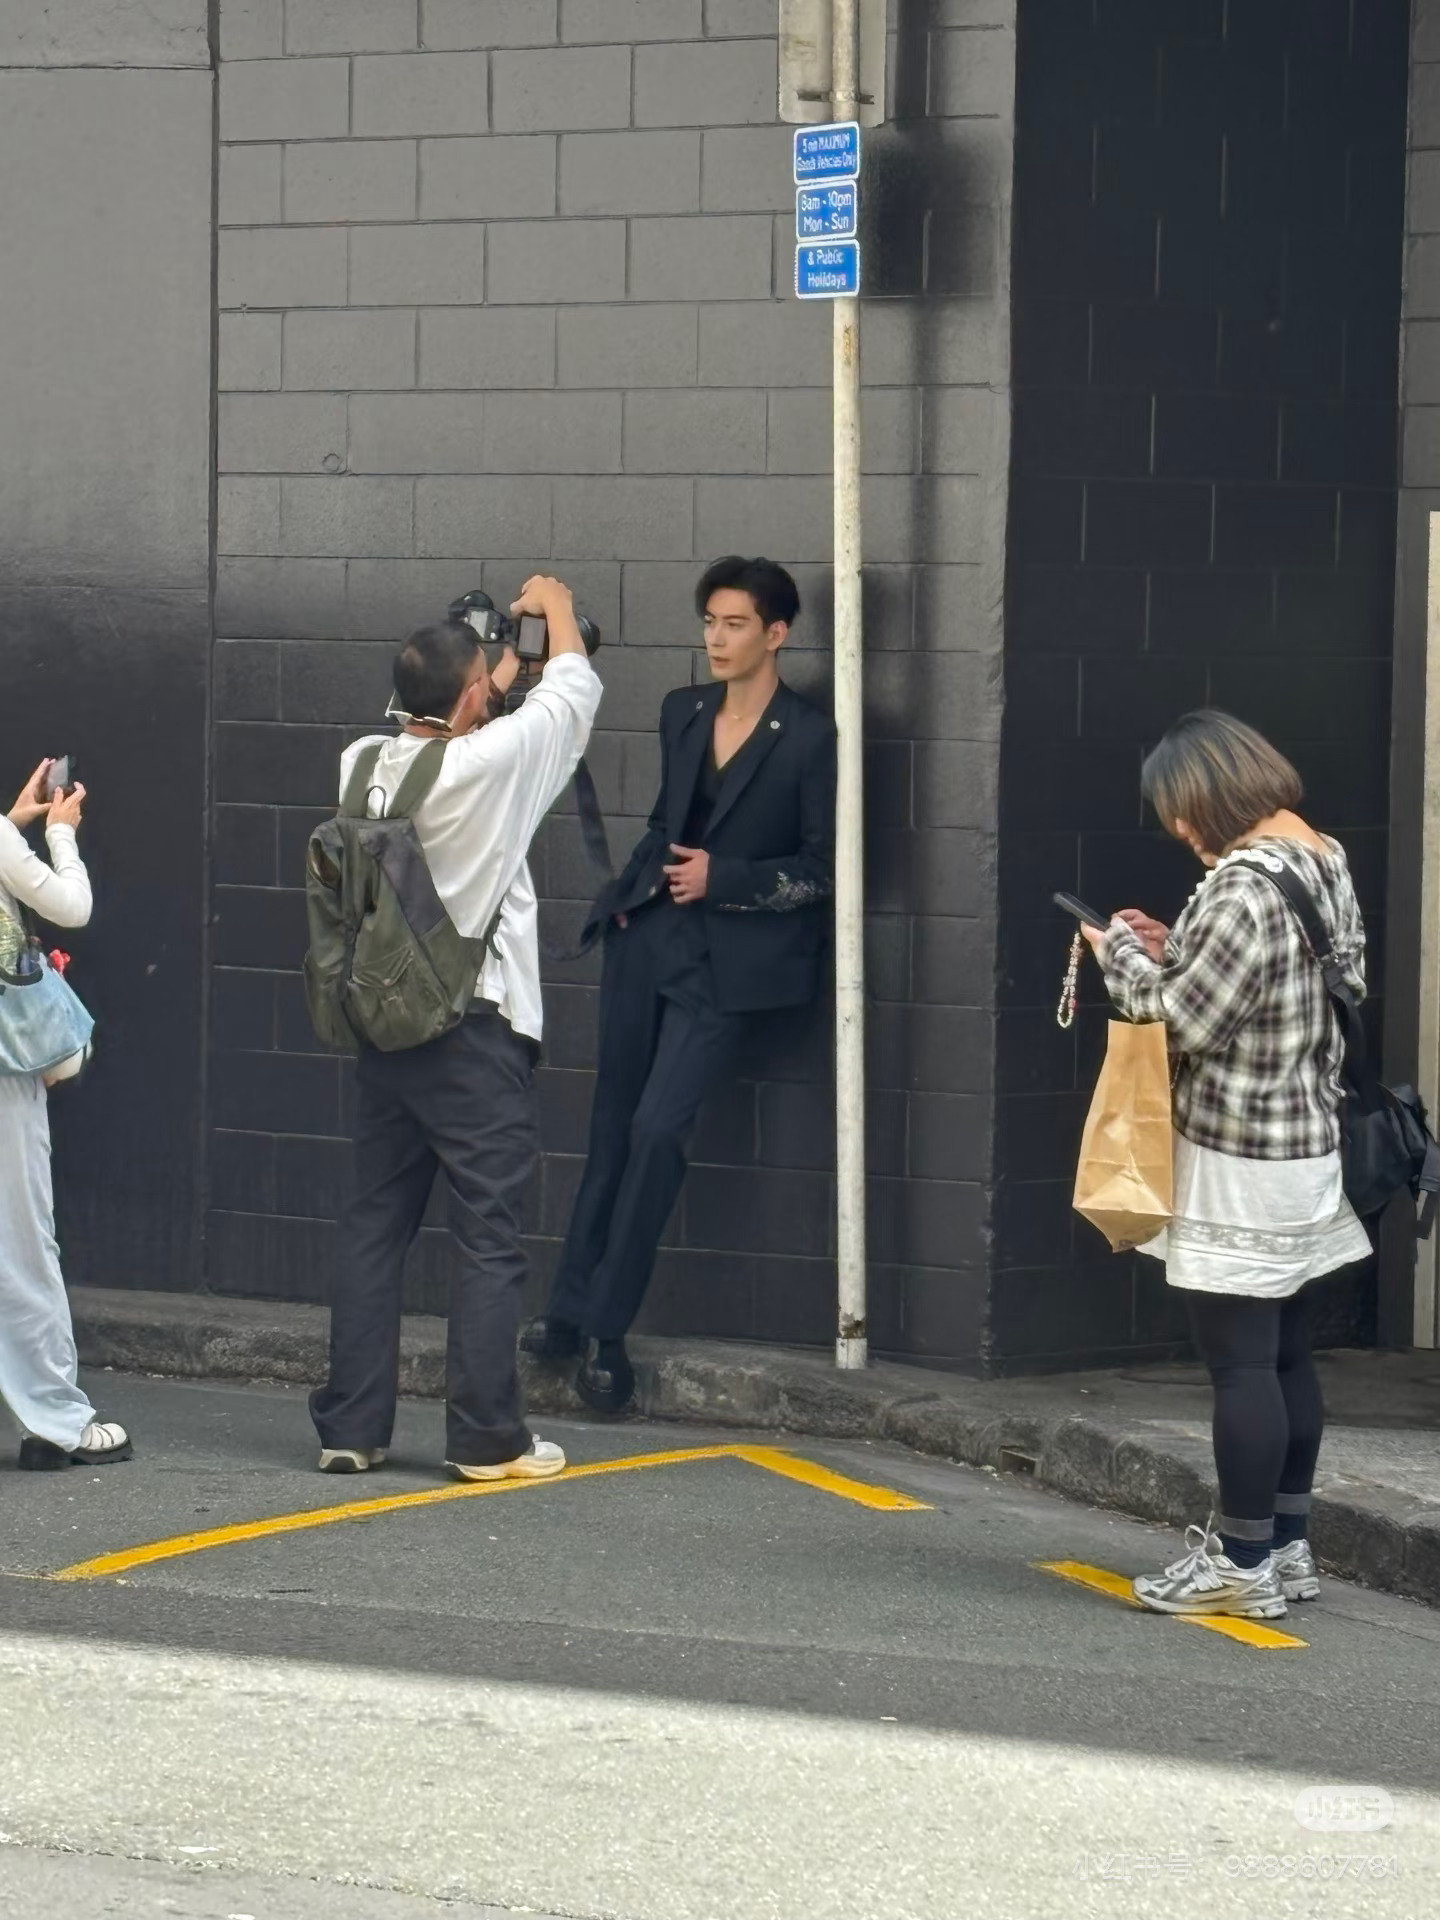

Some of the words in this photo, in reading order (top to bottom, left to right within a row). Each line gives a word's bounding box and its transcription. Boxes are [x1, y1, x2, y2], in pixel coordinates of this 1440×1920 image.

[828, 190, 852, 212] 10pm
[803, 216, 823, 232] Mon
[831, 212, 849, 230] Sun
[807, 251, 815, 266] &
[816, 248, 844, 265] Public
[807, 272, 847, 289] Holidays
